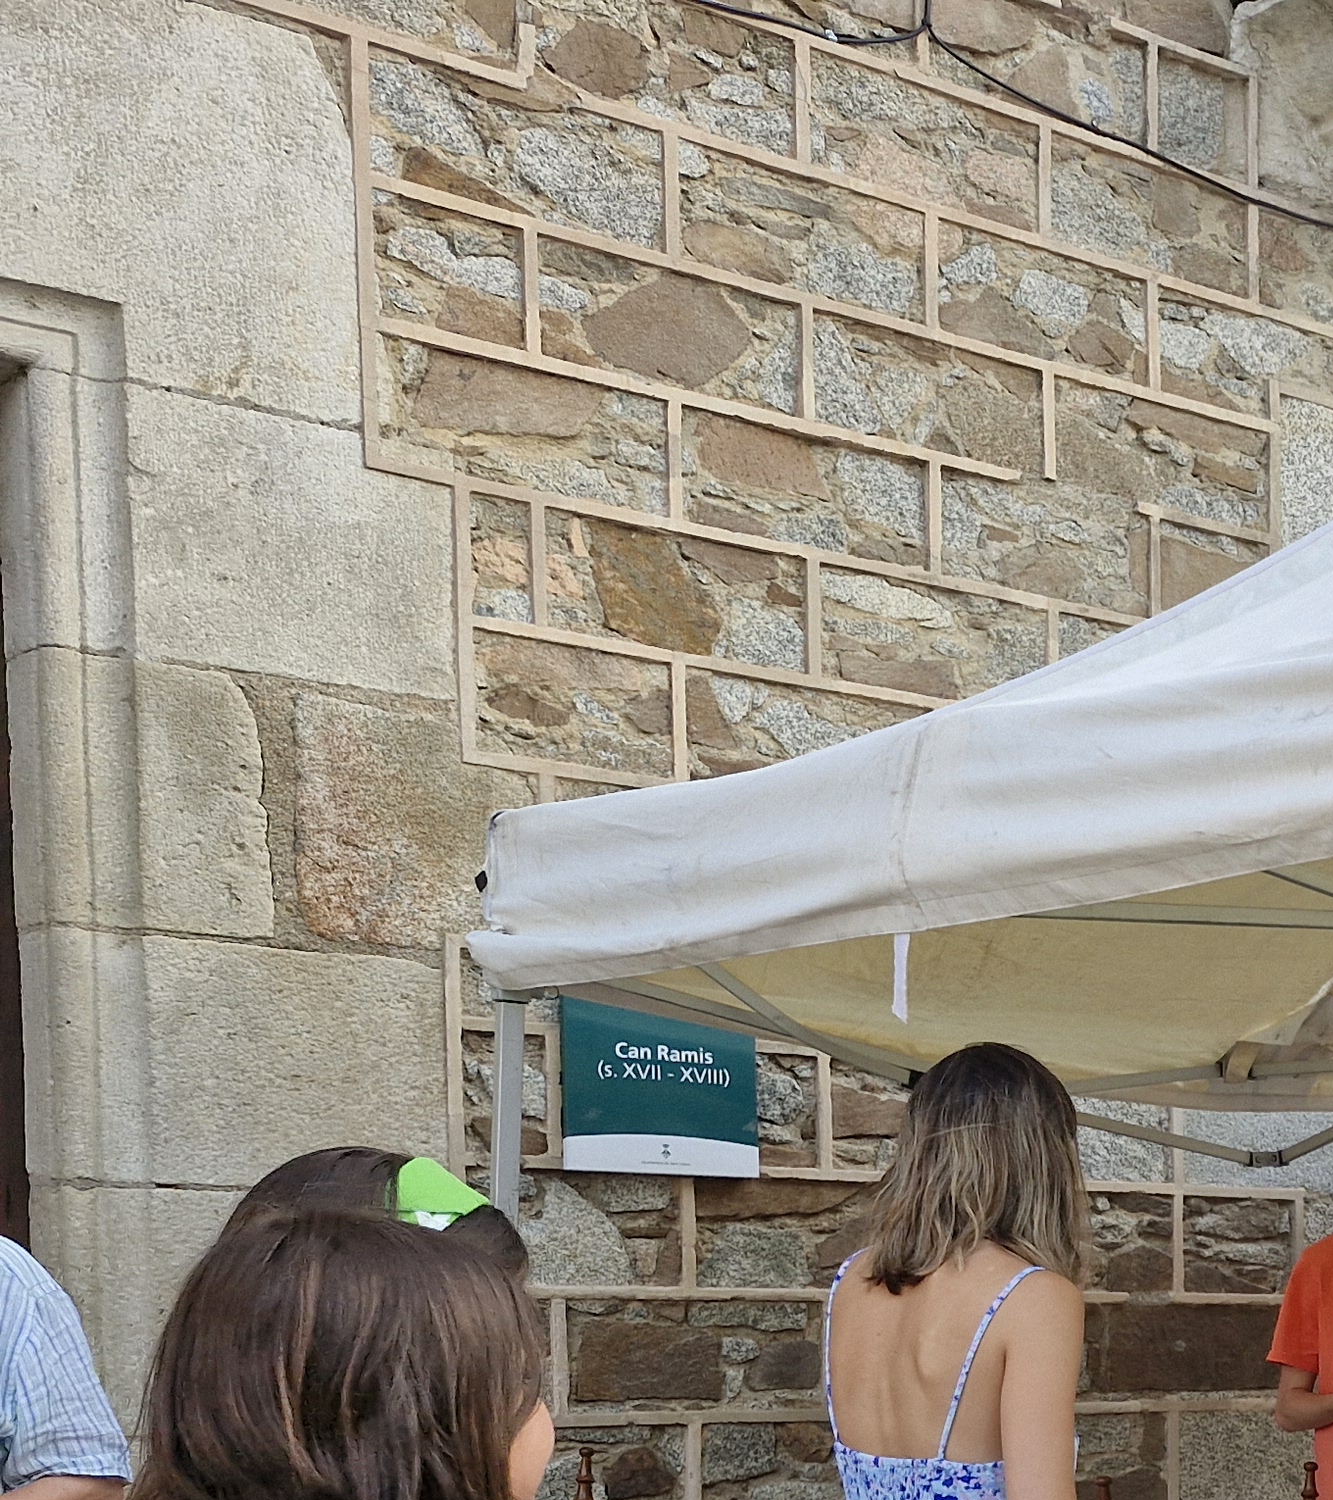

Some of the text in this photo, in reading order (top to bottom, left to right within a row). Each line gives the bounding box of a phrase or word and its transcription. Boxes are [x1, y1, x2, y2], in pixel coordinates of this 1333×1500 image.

[615, 1041, 714, 1065] Can Ramis
[597, 1059, 618, 1080] (s.
[622, 1062, 662, 1081] XVII
[680, 1066, 731, 1088] XVIII)
